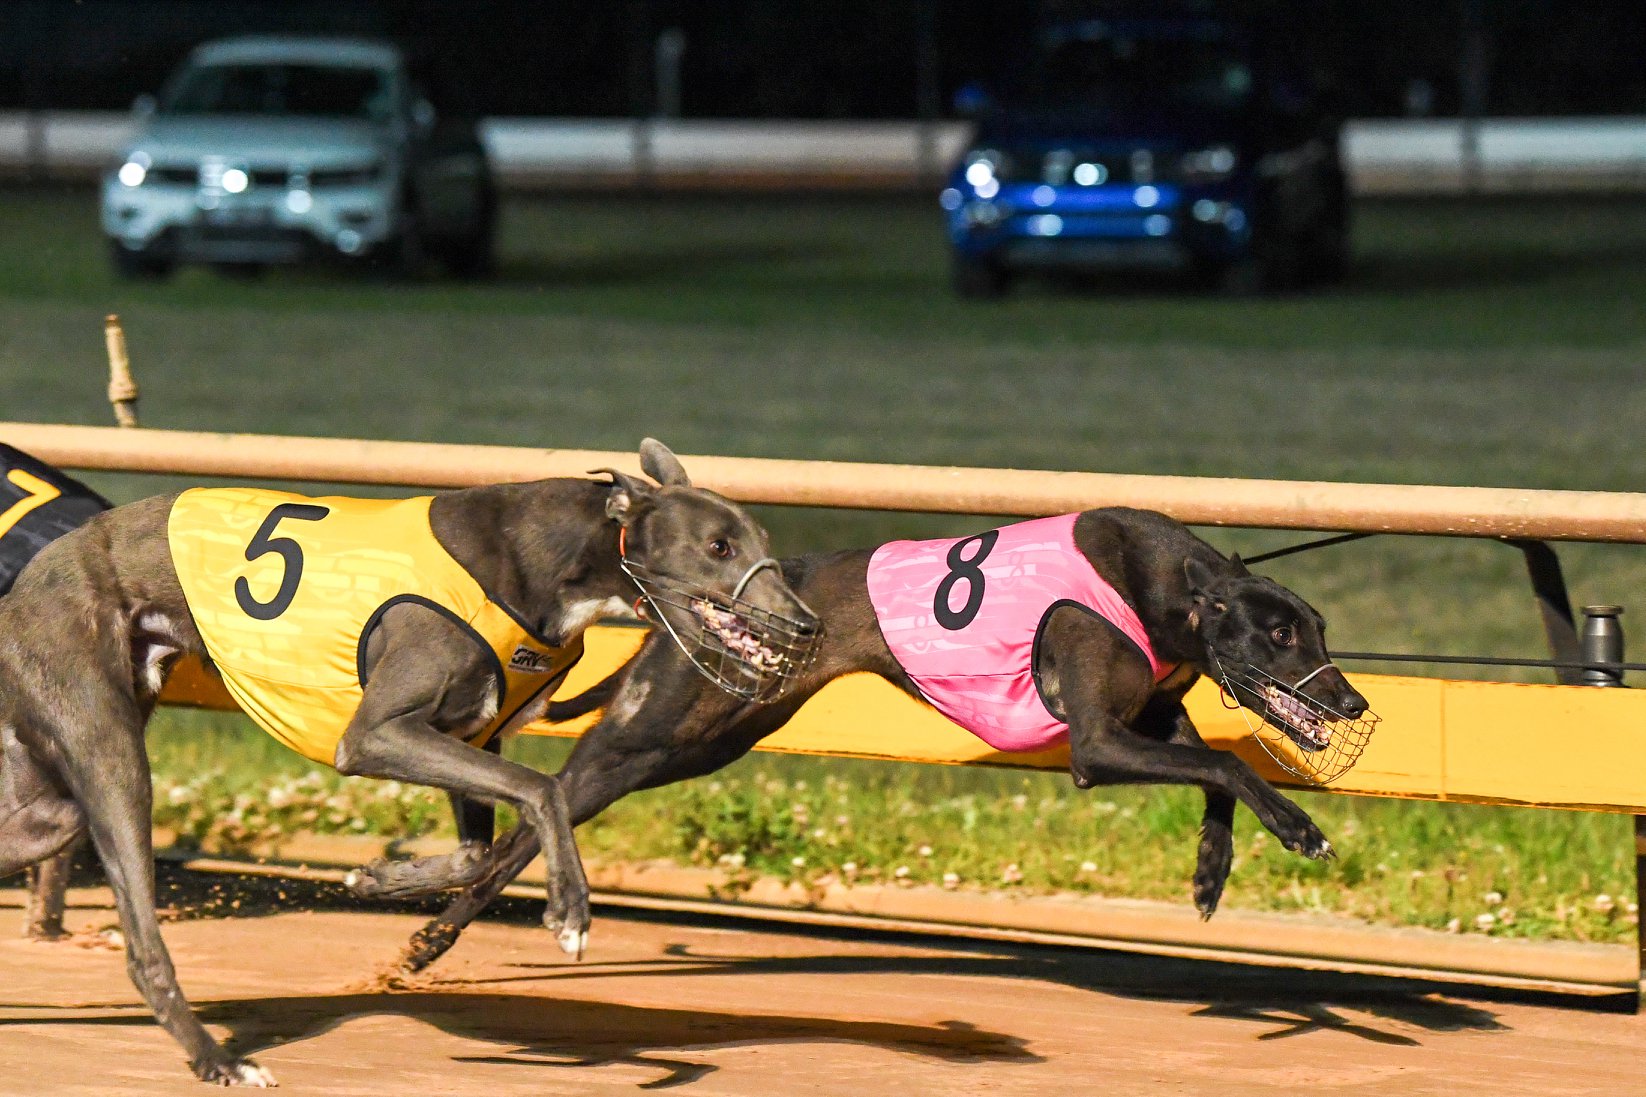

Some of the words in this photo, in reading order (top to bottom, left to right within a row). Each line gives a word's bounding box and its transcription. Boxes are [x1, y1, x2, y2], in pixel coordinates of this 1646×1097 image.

[0, 469, 61, 539] 7
[235, 503, 330, 620] 5
[934, 530, 999, 630] 8
